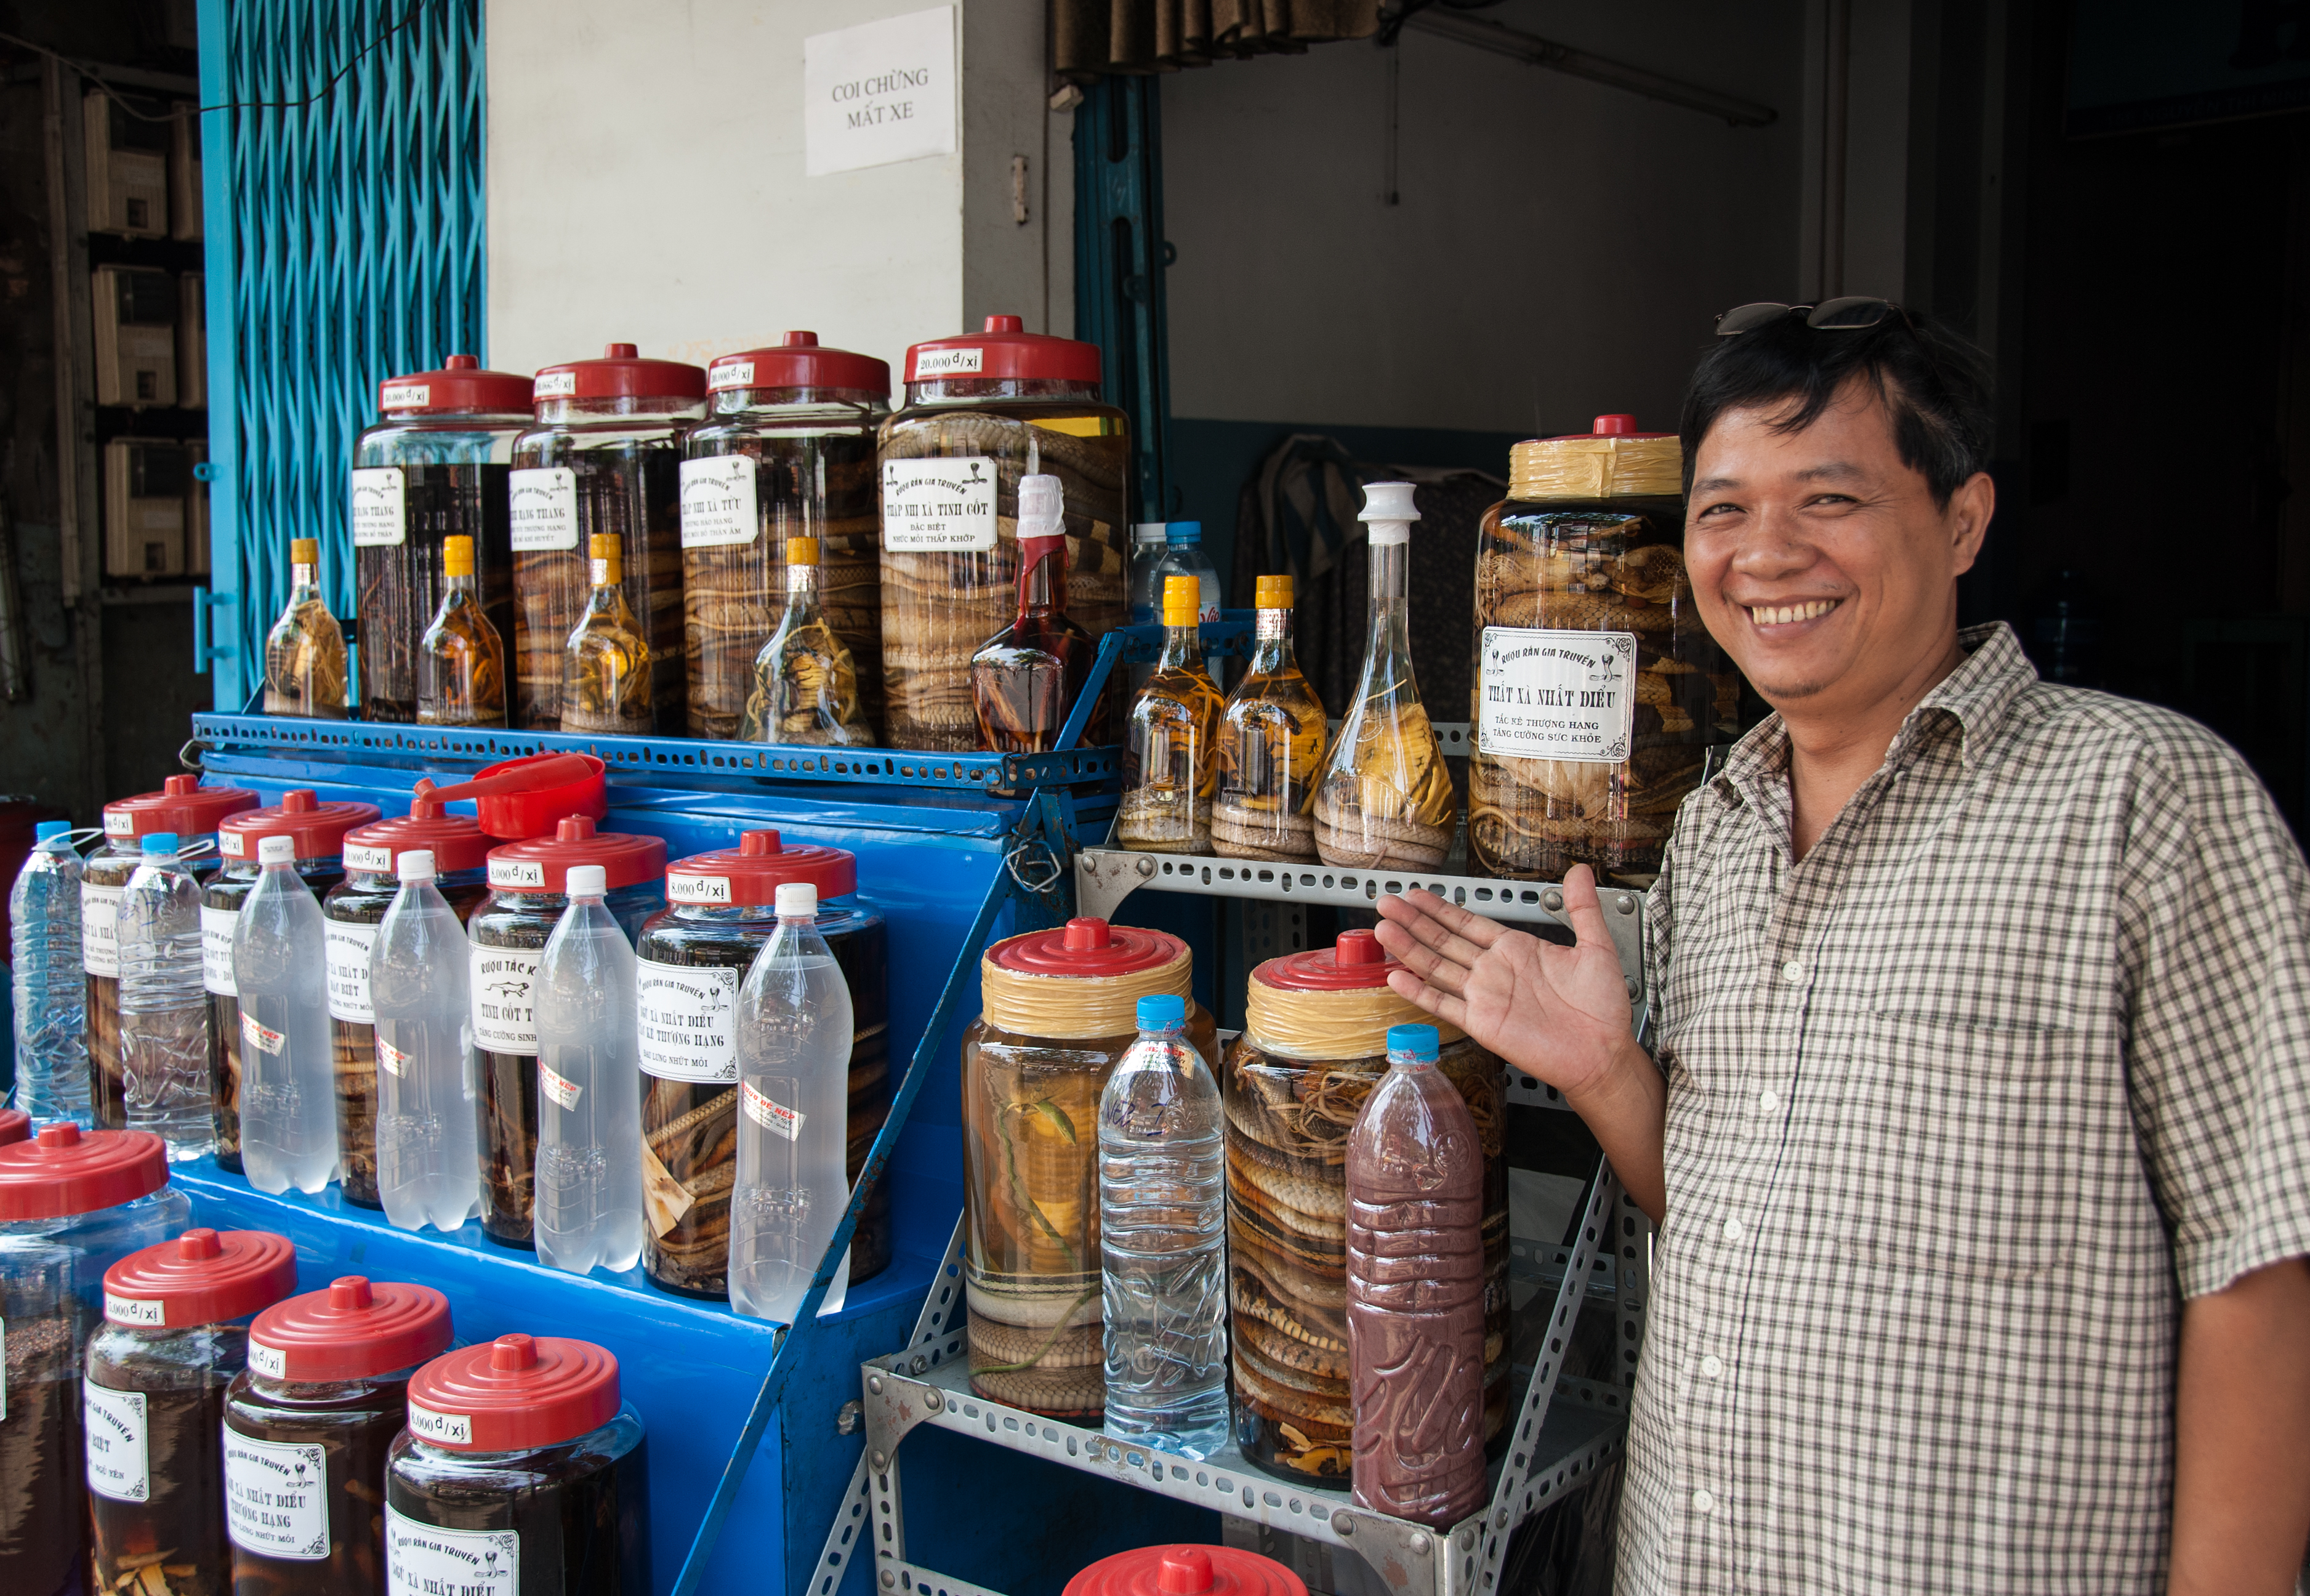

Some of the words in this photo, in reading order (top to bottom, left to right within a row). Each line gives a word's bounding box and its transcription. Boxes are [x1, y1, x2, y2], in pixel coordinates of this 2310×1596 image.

[832, 81, 860, 103] COI
[864, 68, 928, 96] CHỪNG
[847, 100, 885, 129] MẤT
[890, 101, 914, 122] XE
[922, 501, 933, 516] XÀ
[938, 503, 962, 515] TINH
[927, 522, 946, 531] BIỆT
[950, 534, 975, 542] KHỚP
[1501, 650, 1520, 664] RƯỢU
[1523, 645, 1539, 656] RẮN
[1542, 648, 1556, 657] GIA
[1488, 680, 1513, 703] THẤT
[1517, 685, 1531, 704] XÀ
[1537, 684, 1574, 707] NHẤT
[1580, 685, 1616, 708] ĐIỂU
[1495, 713, 1509, 724] TẮC
[1526, 719, 1565, 730] THƯỢNG
[1569, 722, 1599, 732] HẠNG
[1493, 727, 1511, 738] TĂNG
[1514, 730, 1544, 740] CƯỜNG
[1547, 732, 1567, 741] SỨC
[481, 960, 502, 974] RƯỢU
[505, 958, 525, 973] TẮC
[527, 965, 537, 976] K
[665, 980, 674, 988] GIA
[481, 1003, 499, 1020] TINH
[661, 1010, 683, 1026] NHẤT
[688, 1012, 714, 1028] ĐIỂU
[493, 1030, 515, 1041] CƯỜNG
[518, 1033, 537, 1042] SINH
[656, 1030, 690, 1046] THƯỢNG
[694, 1034, 724, 1048] HẠNG
[669, 1055, 689, 1066] NHỨT
[691, 1057, 708, 1067] MỎI
[249, 1453, 259, 1462] GIA
[247, 1487, 272, 1506] NHẤT
[276, 1490, 306, 1509] ĐIỂU
[262, 1512, 291, 1528] HẠNG
[278, 1533, 295, 1543] MỎI
[414, 1536, 427, 1549] RẮN
[429, 1542, 442, 1552] GIA
[408, 1571, 419, 1589] XÀ
[424, 1578, 455, 1596] NHẤT
